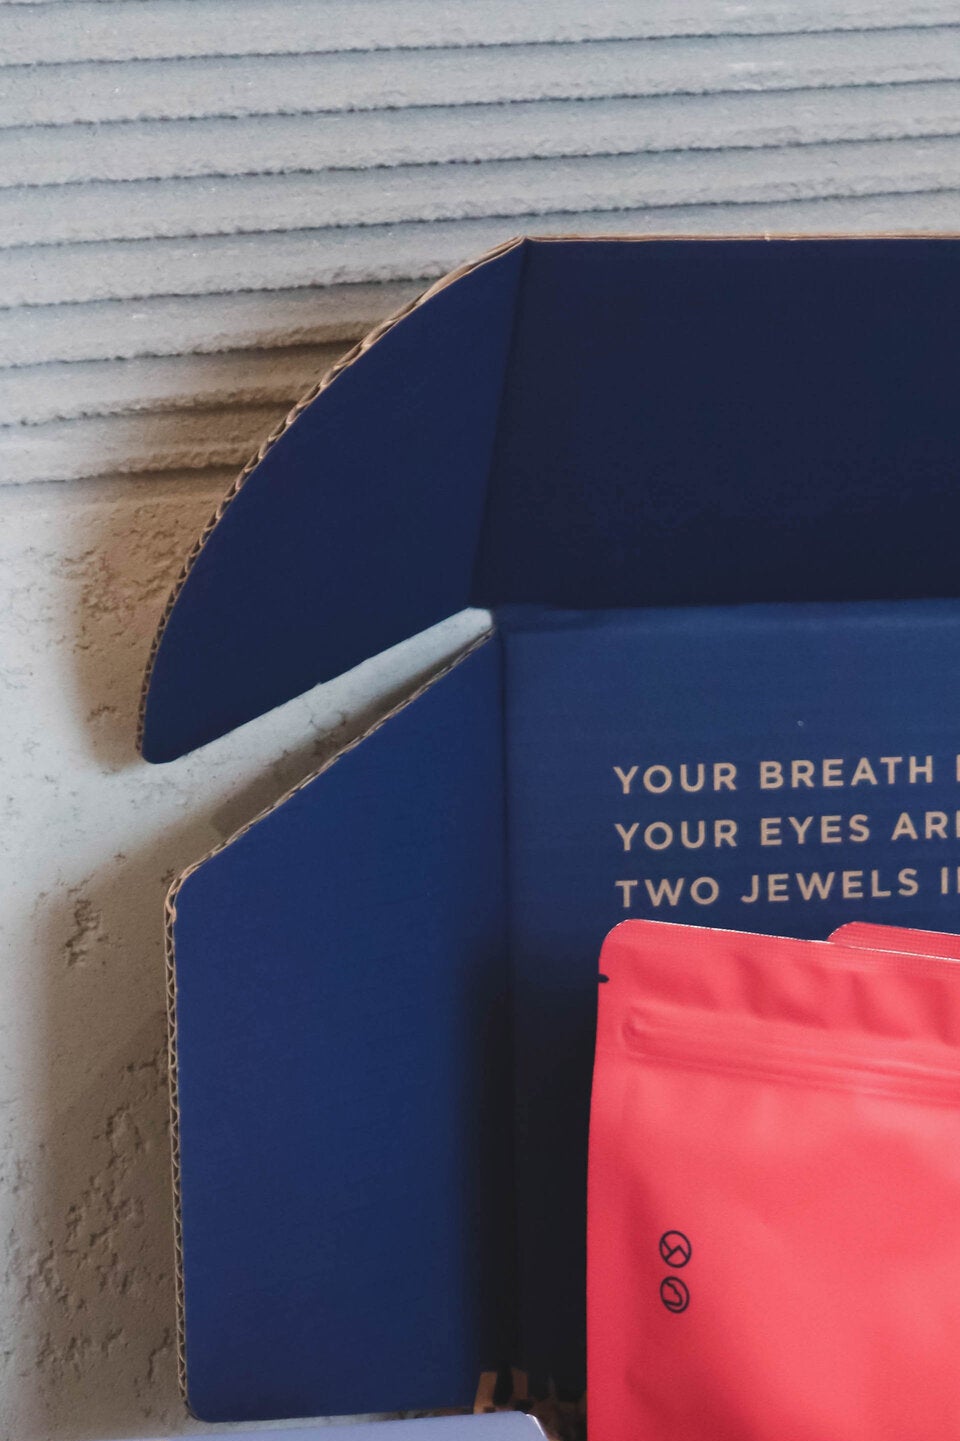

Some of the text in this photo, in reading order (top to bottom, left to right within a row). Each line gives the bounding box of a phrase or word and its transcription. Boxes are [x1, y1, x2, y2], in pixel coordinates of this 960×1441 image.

[613, 763, 737, 794] YOUR
[760, 756, 933, 789] BREATH
[615, 820, 737, 851] YOUR
[761, 814, 870, 846] EYES
[615, 876, 719, 908] TWO
[741, 868, 919, 903] JEWELS
